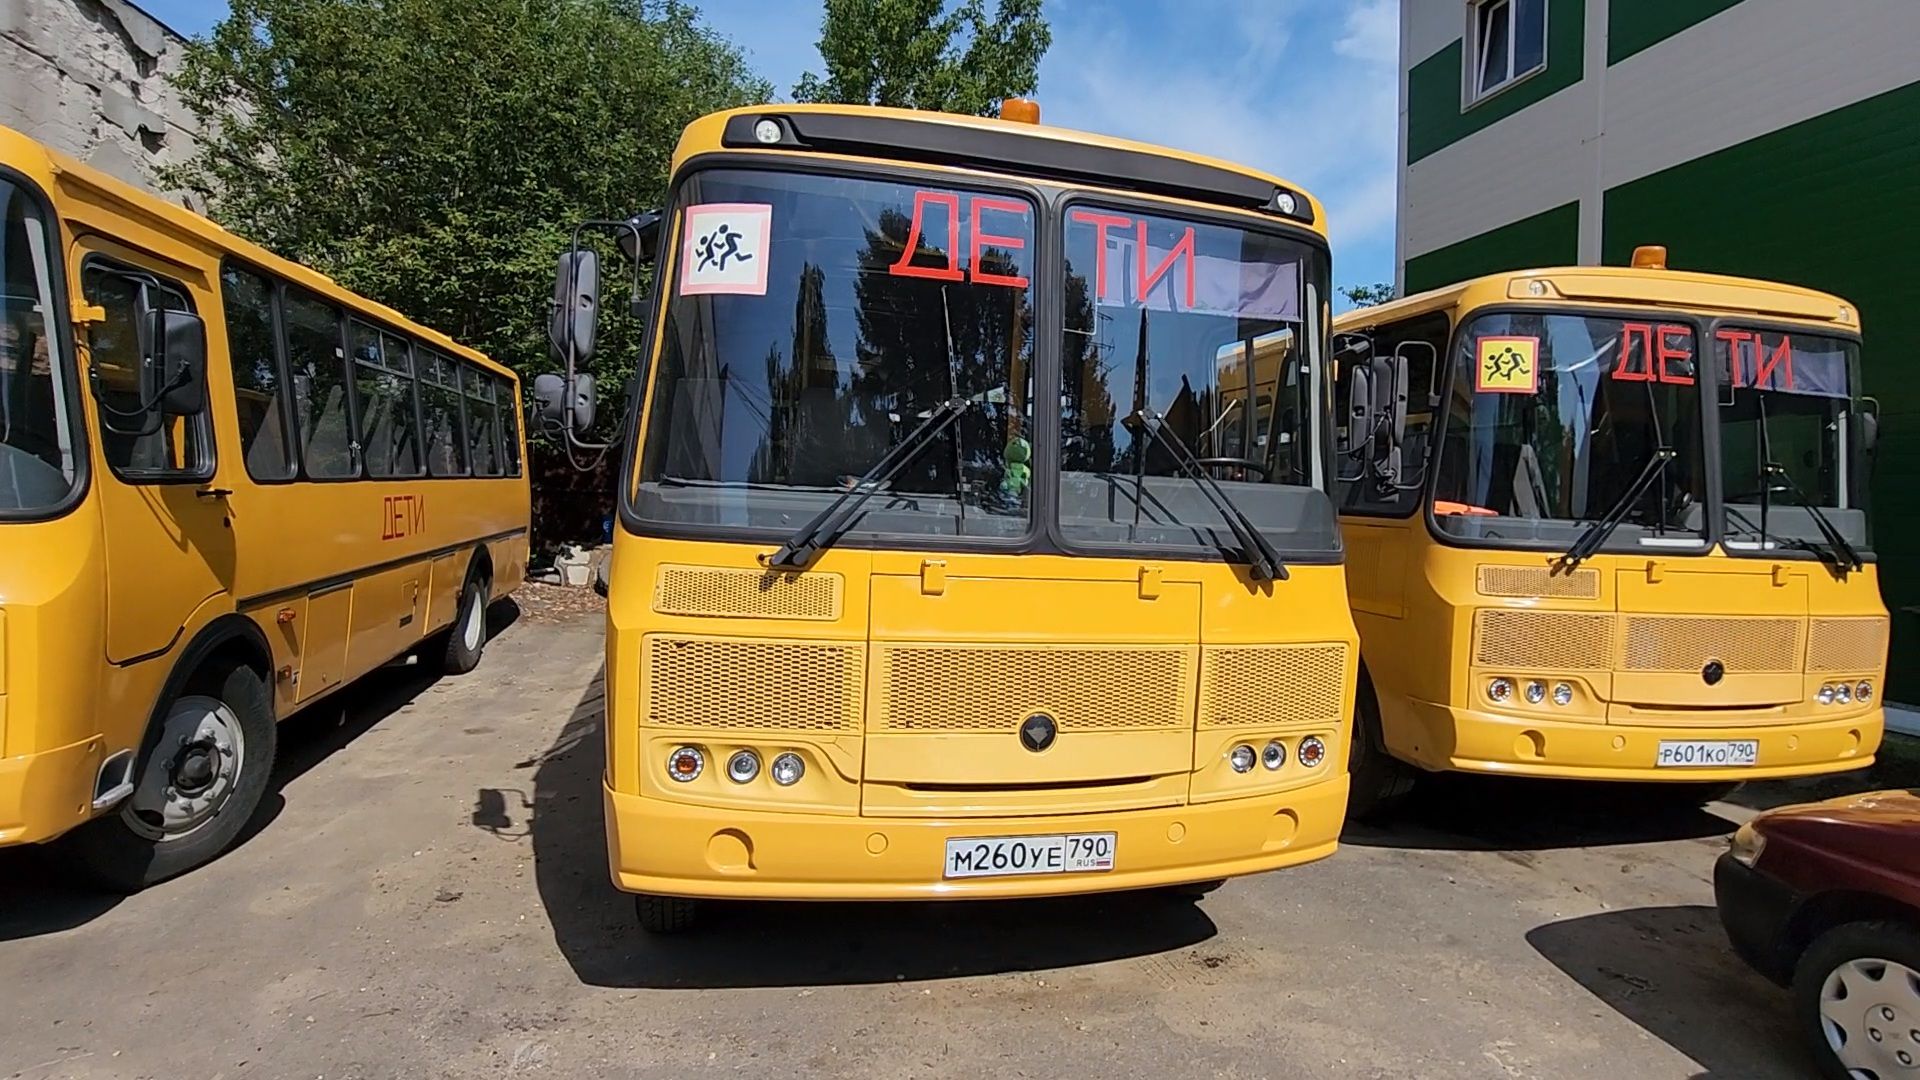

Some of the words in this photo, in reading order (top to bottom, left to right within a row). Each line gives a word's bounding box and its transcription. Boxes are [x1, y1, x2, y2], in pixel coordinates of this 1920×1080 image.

[382, 494, 425, 541] ДЕТИ
[1728, 743, 1753, 758] 790
[954, 842, 1062, 872] М260УЕ
[1068, 837, 1108, 859] 790
[1076, 858, 1096, 867] RUS
